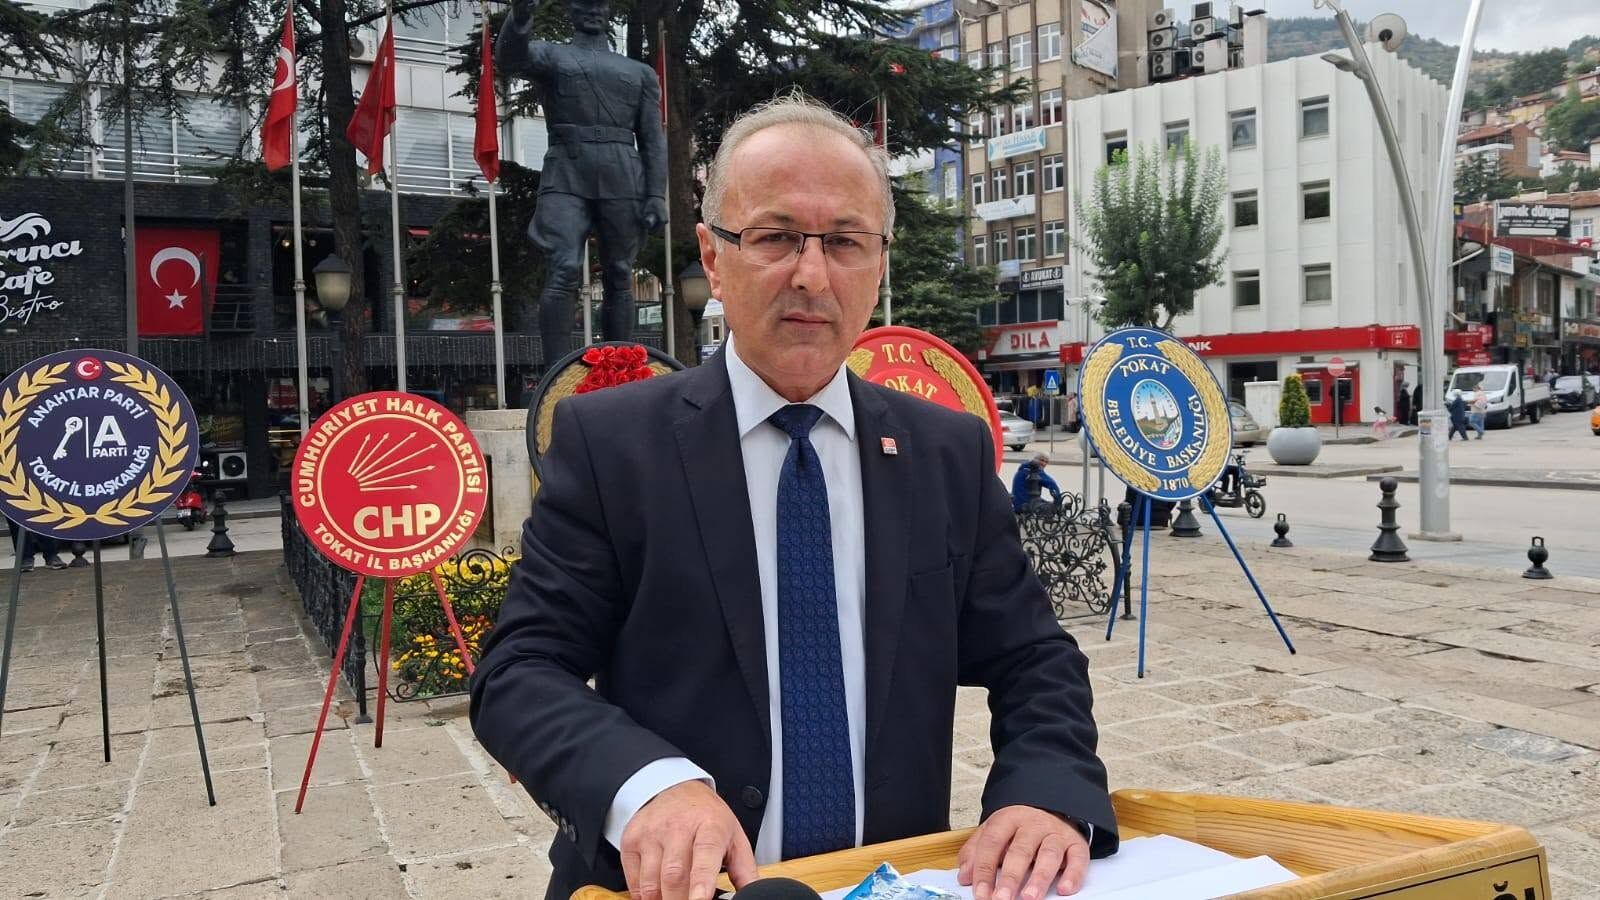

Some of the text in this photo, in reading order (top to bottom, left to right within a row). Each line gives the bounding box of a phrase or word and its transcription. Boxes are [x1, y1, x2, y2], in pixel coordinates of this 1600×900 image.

[0, 240, 83, 265] rıncı
[882, 343, 916, 363] T.C.
[1126, 336, 1152, 349] T.C.
[1120, 359, 1170, 378] TOKAT
[884, 375, 938, 400] OKAT
[28, 386, 149, 428] ANAHTAR PARTİ
[93, 415, 127, 448] A
[1107, 399, 1157, 466] BELEDİYE
[1166, 394, 1206, 469] BAŞKANLIĞI
[92, 447, 128, 458] PARTİ
[298, 397, 484, 508] CUMHURİYET HALK PARTİSİ
[29, 445, 151, 497] TOKAT İL BAŞKANLIĞI
[1162, 477, 1190, 491] 1870
[353, 503, 441, 540] CHP
[313, 509, 476, 571] TOKAT İL BAŞKANLIĞI
